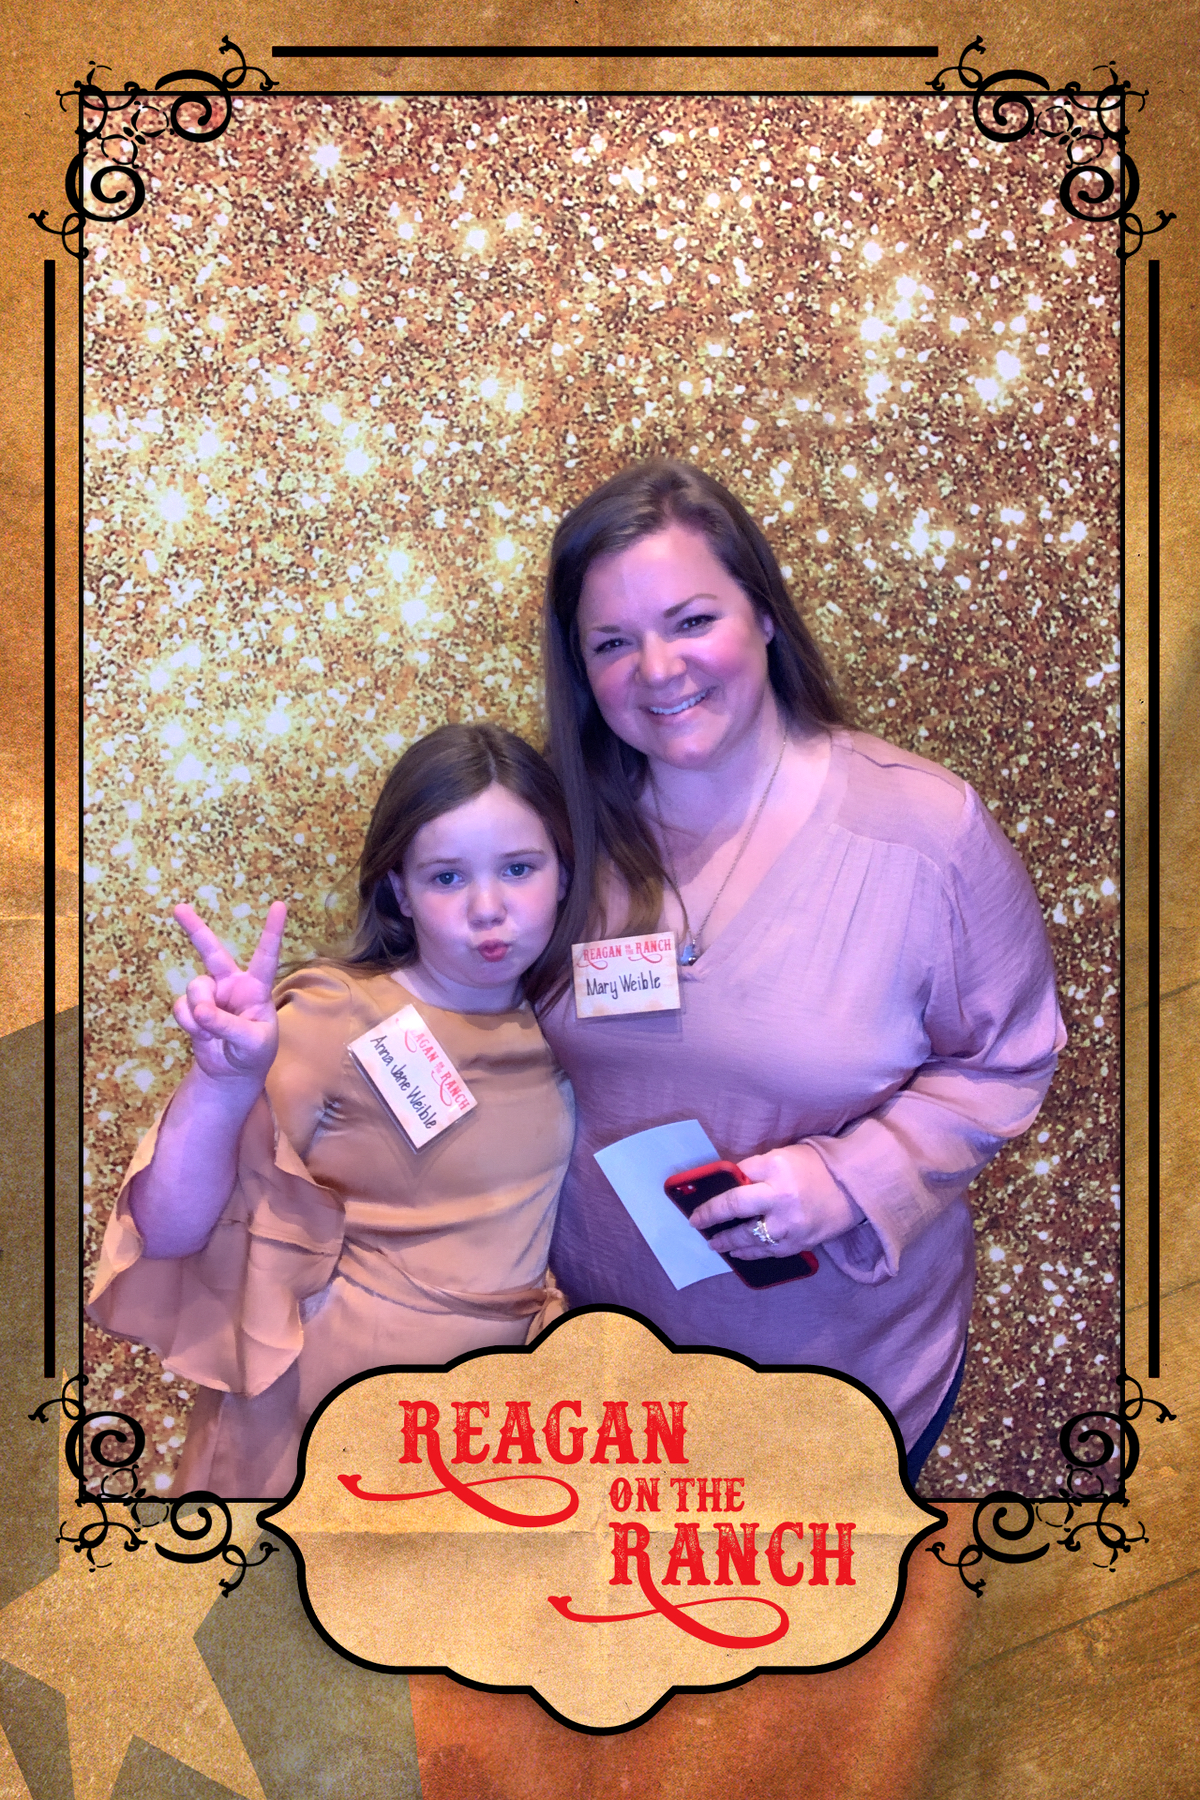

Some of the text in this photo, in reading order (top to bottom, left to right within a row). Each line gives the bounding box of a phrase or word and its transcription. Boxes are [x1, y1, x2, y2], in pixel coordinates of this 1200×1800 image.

[582, 944, 622, 961] REAGAN
[635, 938, 672, 954] RANCH
[586, 970, 661, 1000] Mary Weible
[370, 1035, 437, 1130] Anna Jane Weible
[440, 1070, 471, 1111] RANCH
